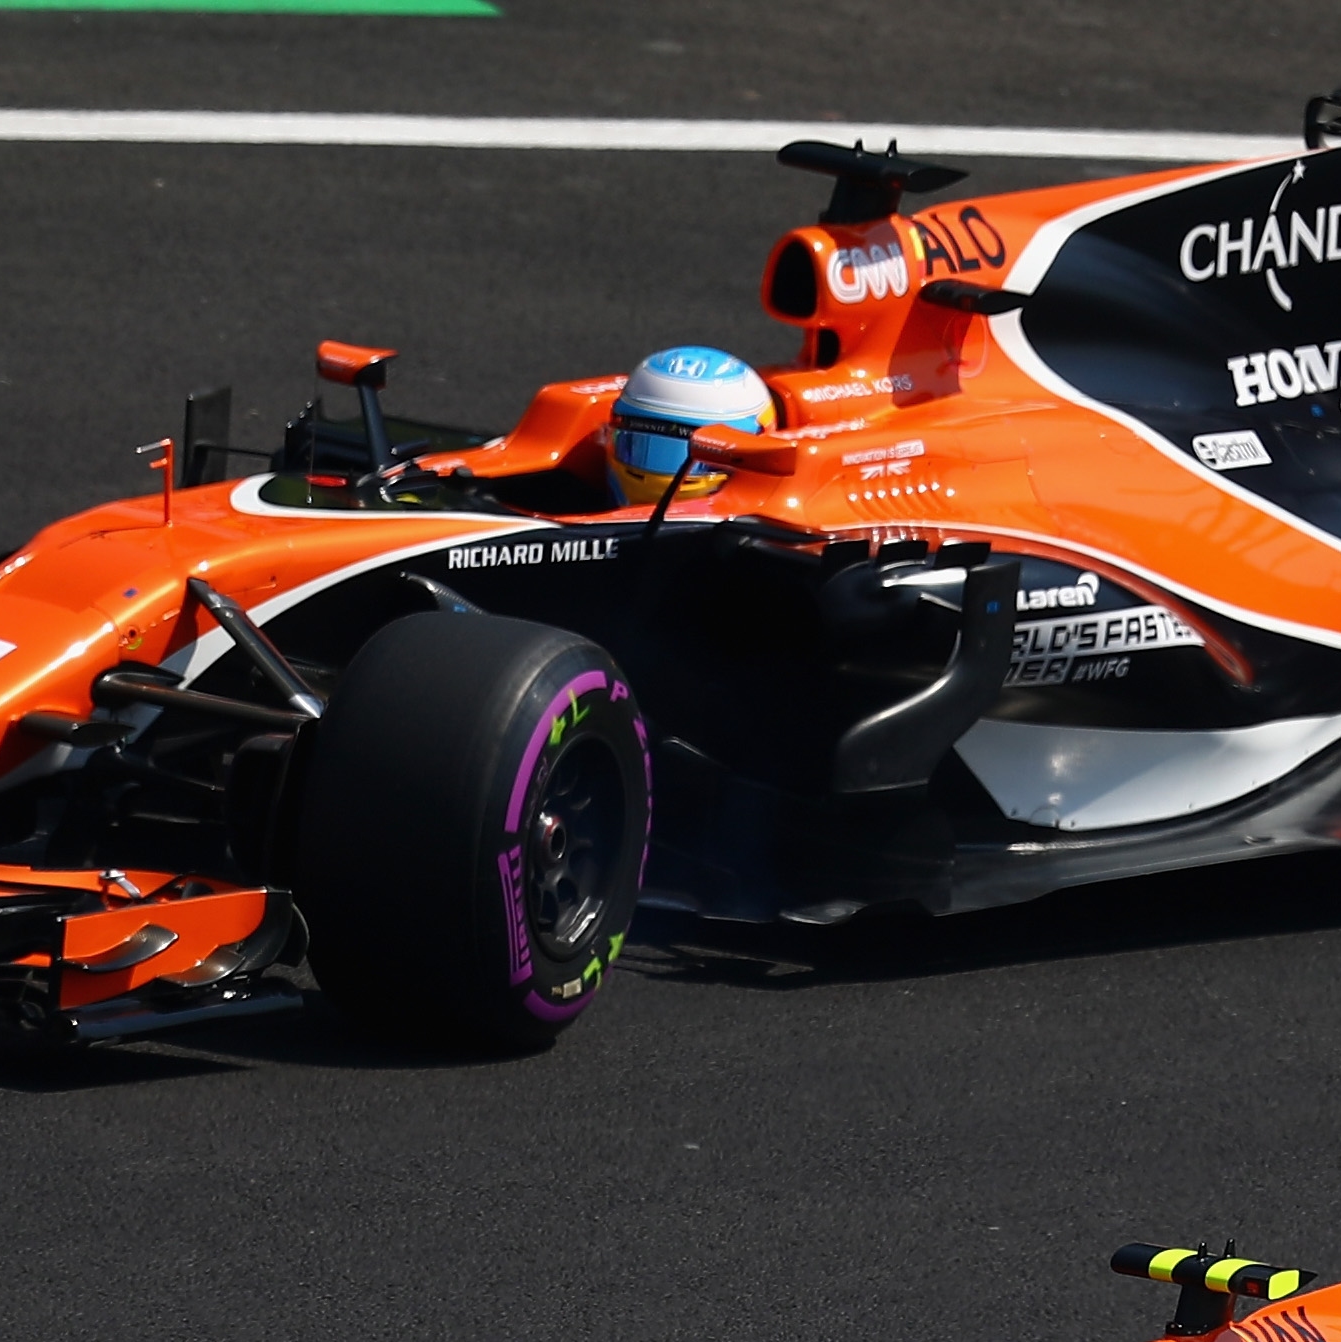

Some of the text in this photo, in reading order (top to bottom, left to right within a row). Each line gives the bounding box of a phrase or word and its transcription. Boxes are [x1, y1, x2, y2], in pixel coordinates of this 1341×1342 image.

[911, 205, 1005, 276] ALO
[827, 243, 909, 304] CNN
[809, 374, 914, 403] MICHAEL KORS
[449, 537, 620, 570] RICHARD MILLE
[1016, 584, 1097, 612] Laren
[1071, 657, 1132, 682] #WFG
